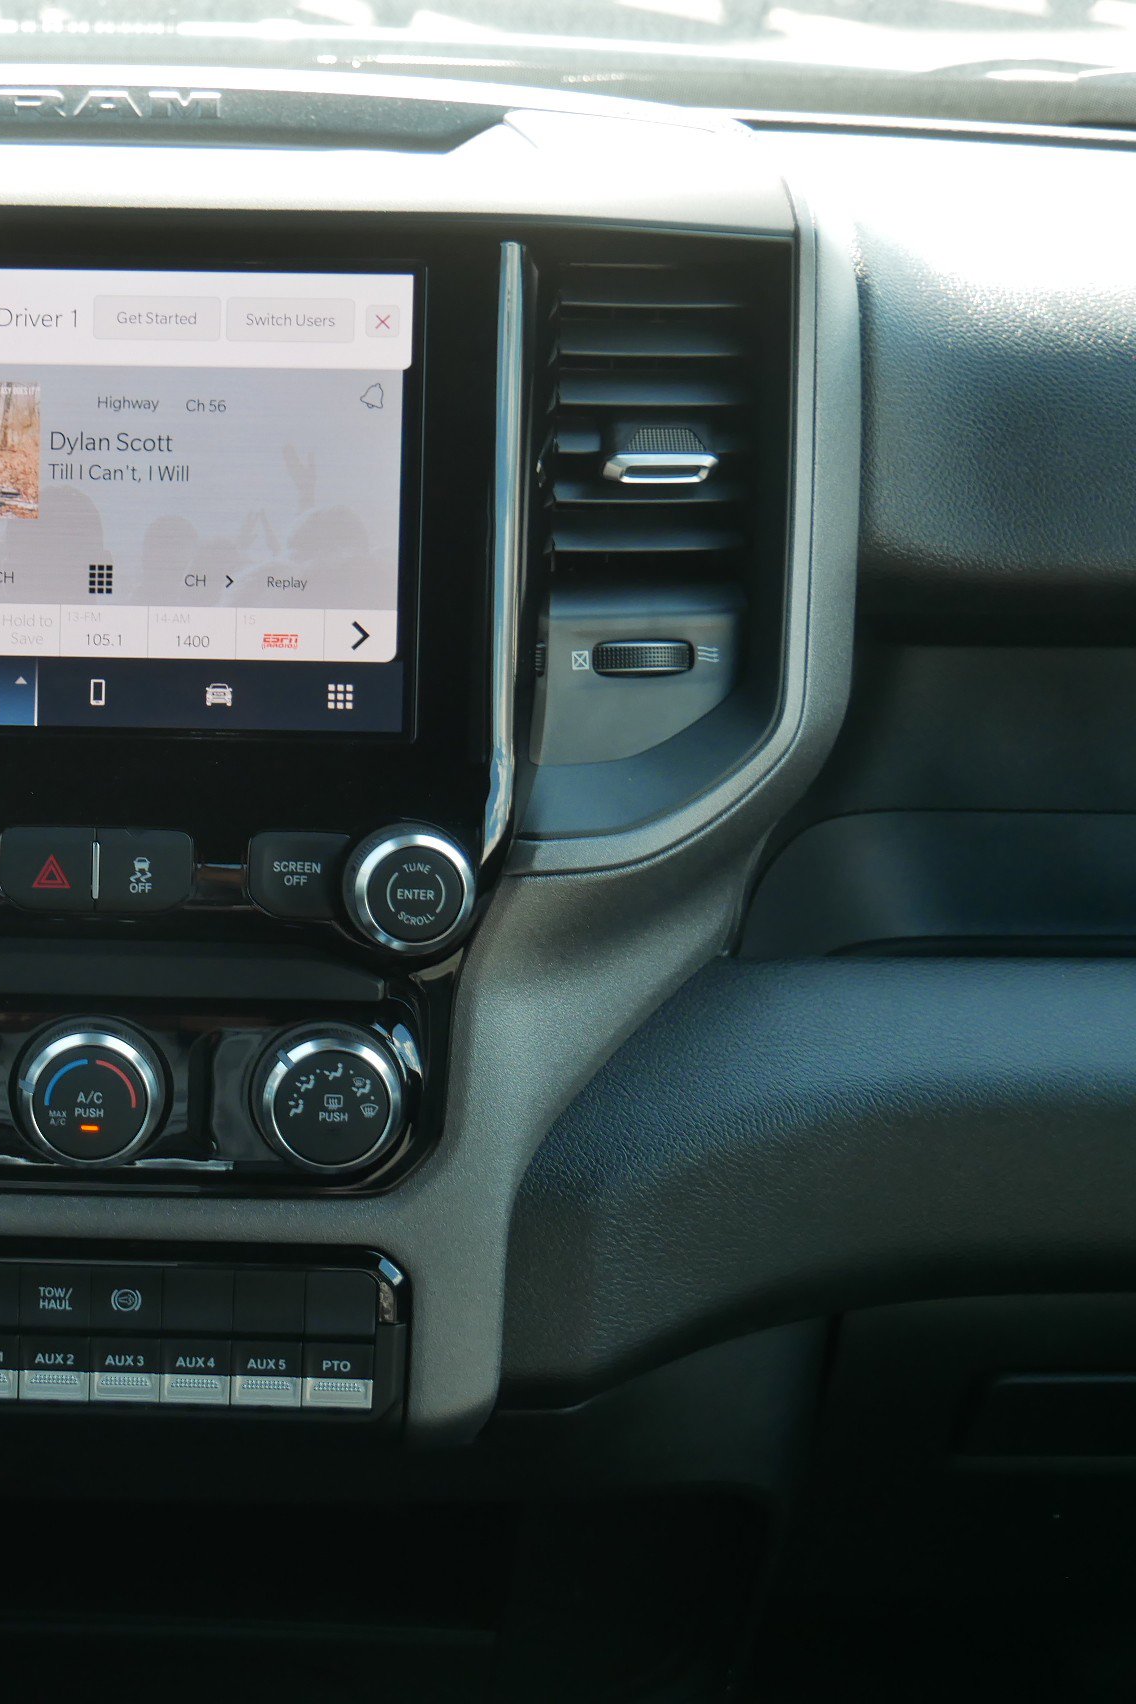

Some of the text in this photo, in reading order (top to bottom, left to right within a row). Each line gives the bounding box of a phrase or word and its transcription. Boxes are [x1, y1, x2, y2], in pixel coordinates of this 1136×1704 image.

[71, 309, 78, 328] 1
[116, 311, 197, 326] Get Started
[246, 313, 335, 328] Switch Users
[97, 396, 227, 413] Highway Ch 56
[50, 431, 173, 455] Dylan Scott
[48, 464, 73, 480] Till
[88, 464, 141, 482] Can't,
[158, 466, 190, 482] Will
[184, 574, 207, 587] CH
[267, 576, 308, 591] Replay
[2, 614, 53, 628] Hold to
[11, 632, 44, 645] Save
[85, 633, 123, 646] 105.1
[176, 635, 210, 648] 1400
[263, 634, 298, 643] ESPN
[273, 861, 321, 874] SCREEN
[402, 863, 432, 875] TUNE
[284, 876, 307, 886] OFF
[129, 882, 152, 894] OFF
[397, 888, 434, 901] ENTER
[398, 911, 435, 926] SCROLL
[77, 1090, 103, 1104] A/C
[48, 1109, 67, 1118] MAX
[74, 1107, 104, 1118] PUSH
[318, 1111, 349, 1122] PUSH
[38, 1285, 73, 1299] TOW/
[39, 1297, 72, 1310] HAUL
[35, 1353, 75, 1365] AUX 2
[105, 1354, 144, 1367] AUX 3
[176, 1356, 215, 1369] AUX 4
[247, 1358, 286, 1371] AUX 5
[322, 1360, 351, 1372] PTO
